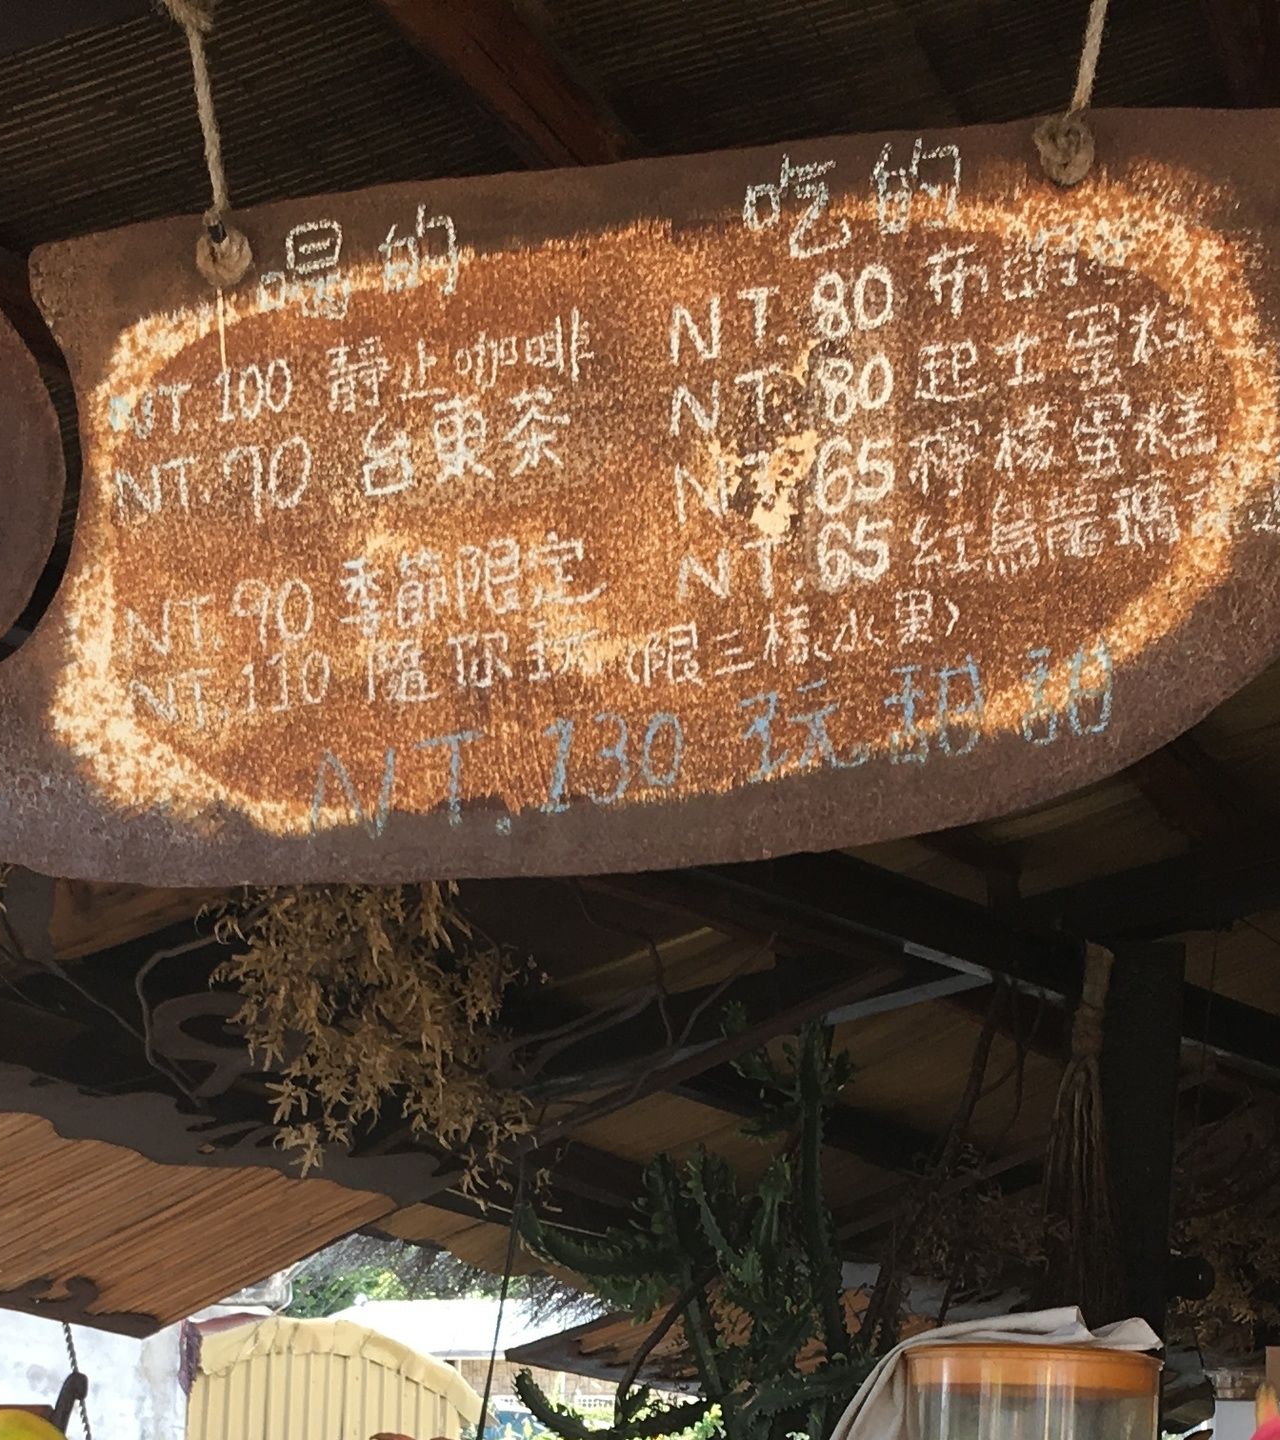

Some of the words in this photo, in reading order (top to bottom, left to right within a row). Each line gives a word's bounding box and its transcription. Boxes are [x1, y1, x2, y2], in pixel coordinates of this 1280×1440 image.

[742, 138, 963, 259] 吃的
[257, 204, 460, 320] 喝的
[925, 222, 1140, 319] 布朗
[361, 385, 570, 496] 台東茶
[675, 436, 895, 523] NT65
[339, 532, 607, 636] 季節限定
